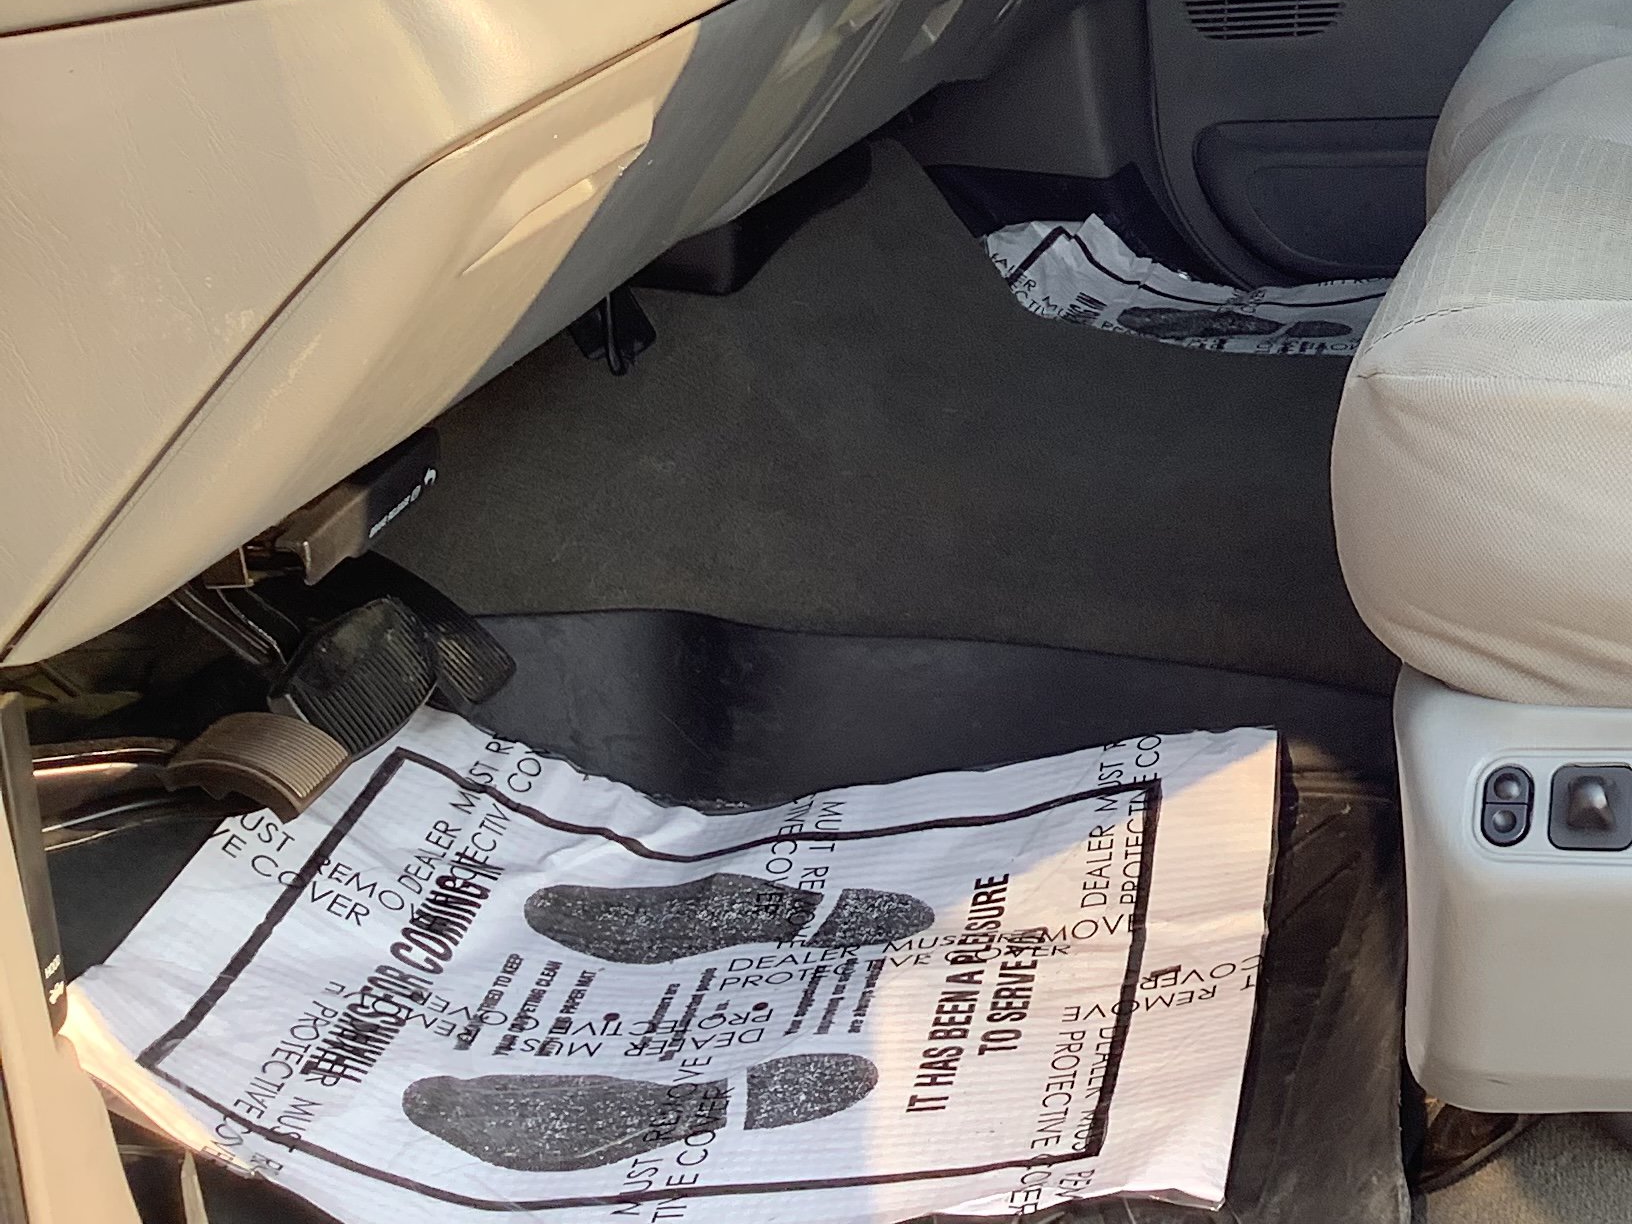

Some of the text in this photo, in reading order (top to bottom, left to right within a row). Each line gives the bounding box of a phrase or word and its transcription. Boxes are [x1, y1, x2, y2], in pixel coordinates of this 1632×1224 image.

[397, 819, 462, 895] DEALER
[448, 760, 499, 815] MST
[808, 801, 847, 853] MUT
[251, 854, 370, 927] COVER
[1080, 824, 1116, 908] DEALER
[728, 944, 861, 973] DEALER
[882, 933, 976, 954] MUS
[945, 968, 985, 985] A
[928, 990, 981, 1041] BEEN
[986, 958, 1038, 1022] SERVE
[233, 999, 339, 1120] PROTECTIVE
[913, 1045, 964, 1088] HAS
[977, 1028, 1023, 1056] TO
[905, 1093, 950, 1114] IT
[1030, 1029, 1087, 1150] PROTECTIVE
[266, 1096, 324, 1154] MUS
